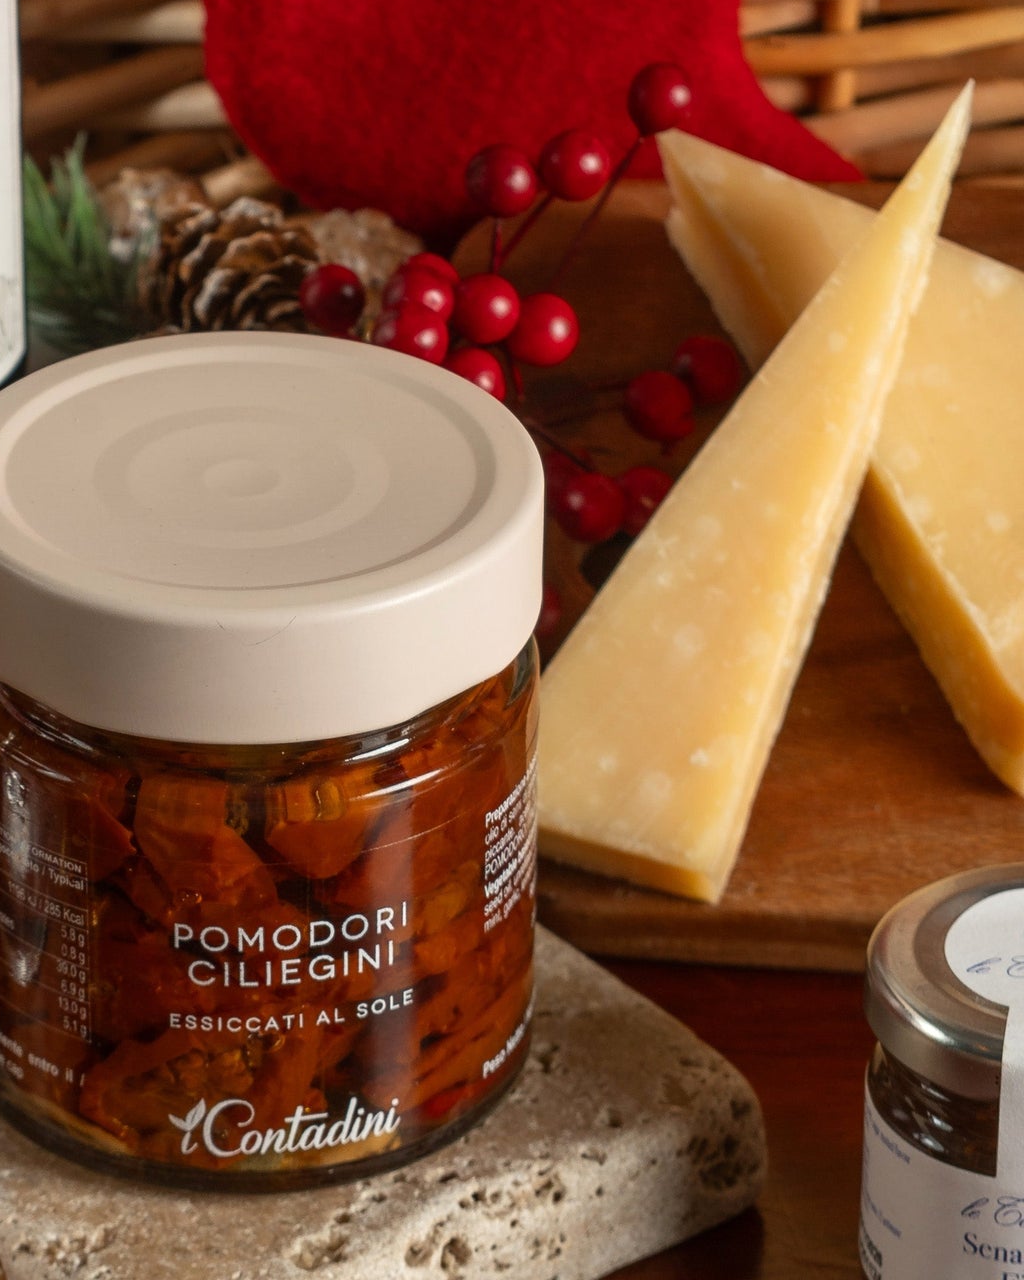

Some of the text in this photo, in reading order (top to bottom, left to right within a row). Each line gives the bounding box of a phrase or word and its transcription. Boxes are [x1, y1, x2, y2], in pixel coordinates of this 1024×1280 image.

[174, 901, 407, 952] POMODORI
[188, 940, 394, 987] CILIEGINI
[169, 988, 414, 1032] ESSICCATI AL SOLE
[202, 1097, 401, 1158] Contadini
